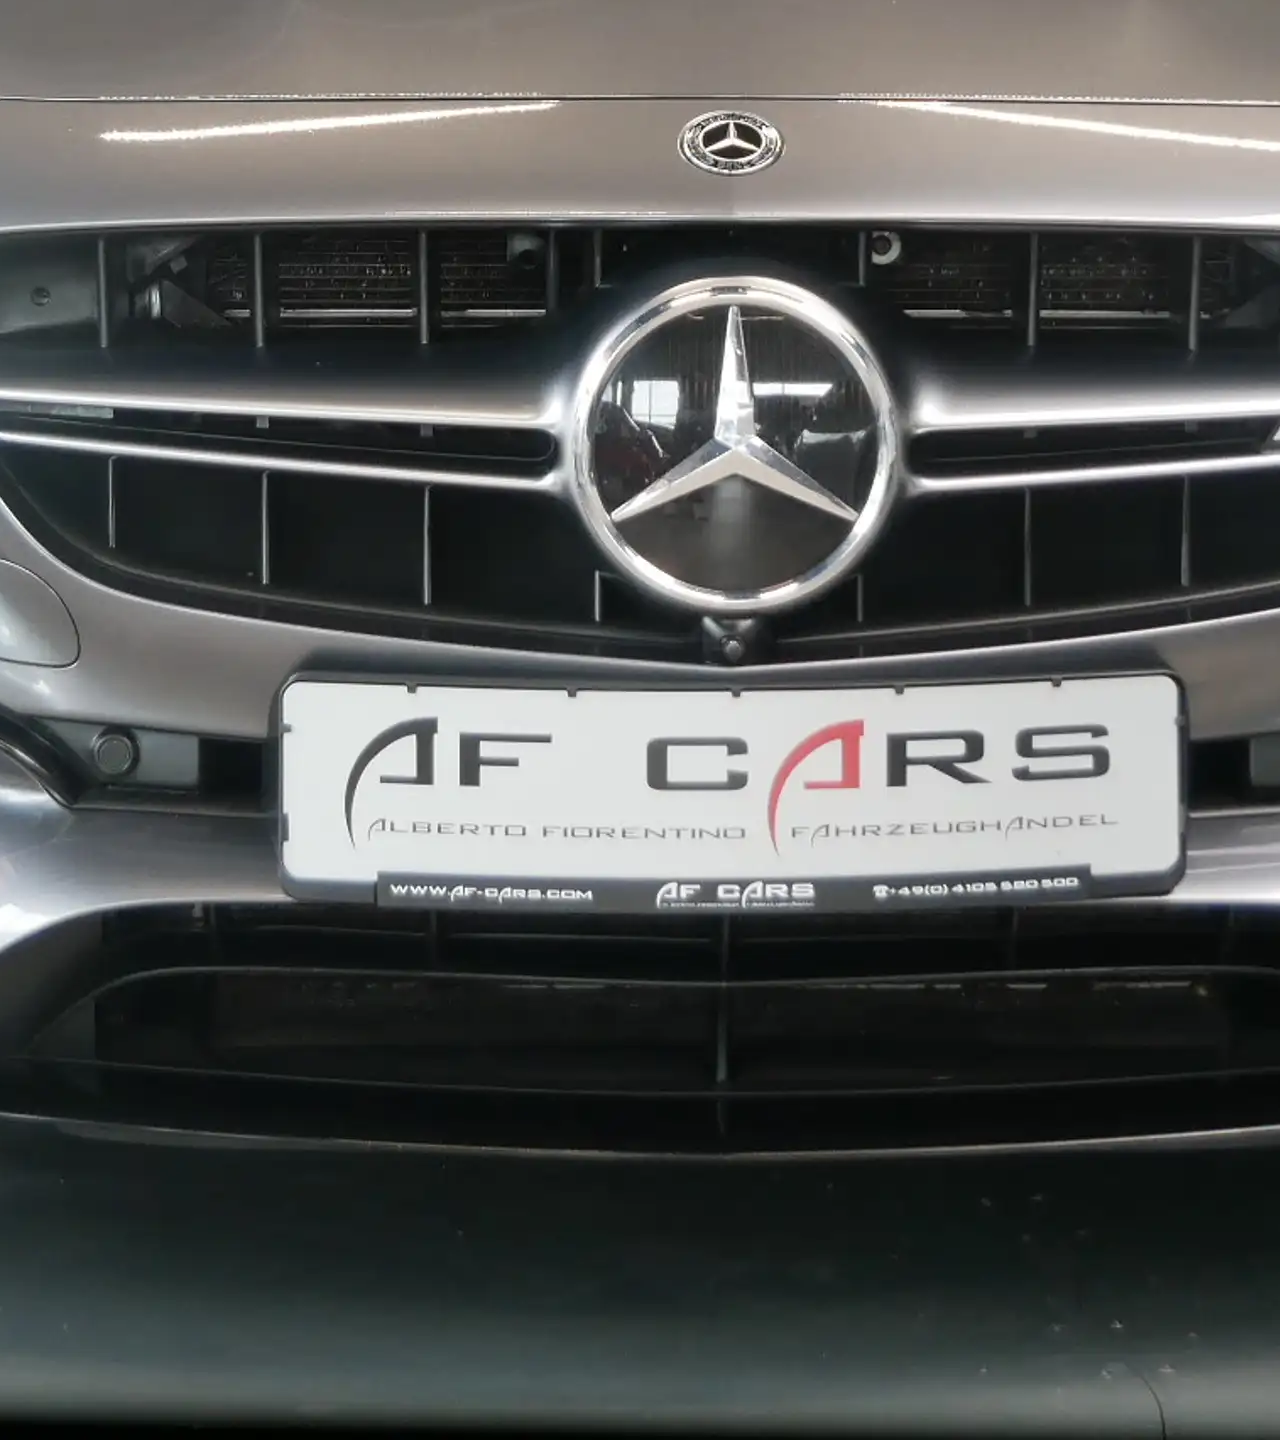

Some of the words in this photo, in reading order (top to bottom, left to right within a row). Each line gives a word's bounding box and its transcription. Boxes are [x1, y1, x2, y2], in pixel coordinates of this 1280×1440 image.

[344, 715, 553, 850] AF
[646, 718, 1111, 857] CARS
[367, 817, 527, 842] ALBERTO
[541, 824, 747, 841] FIORENTINO
[790, 813, 1120, 848] FAHRZEUGHANDEL
[655, 881, 702, 909] AF
[716, 879, 816, 909] CARS
